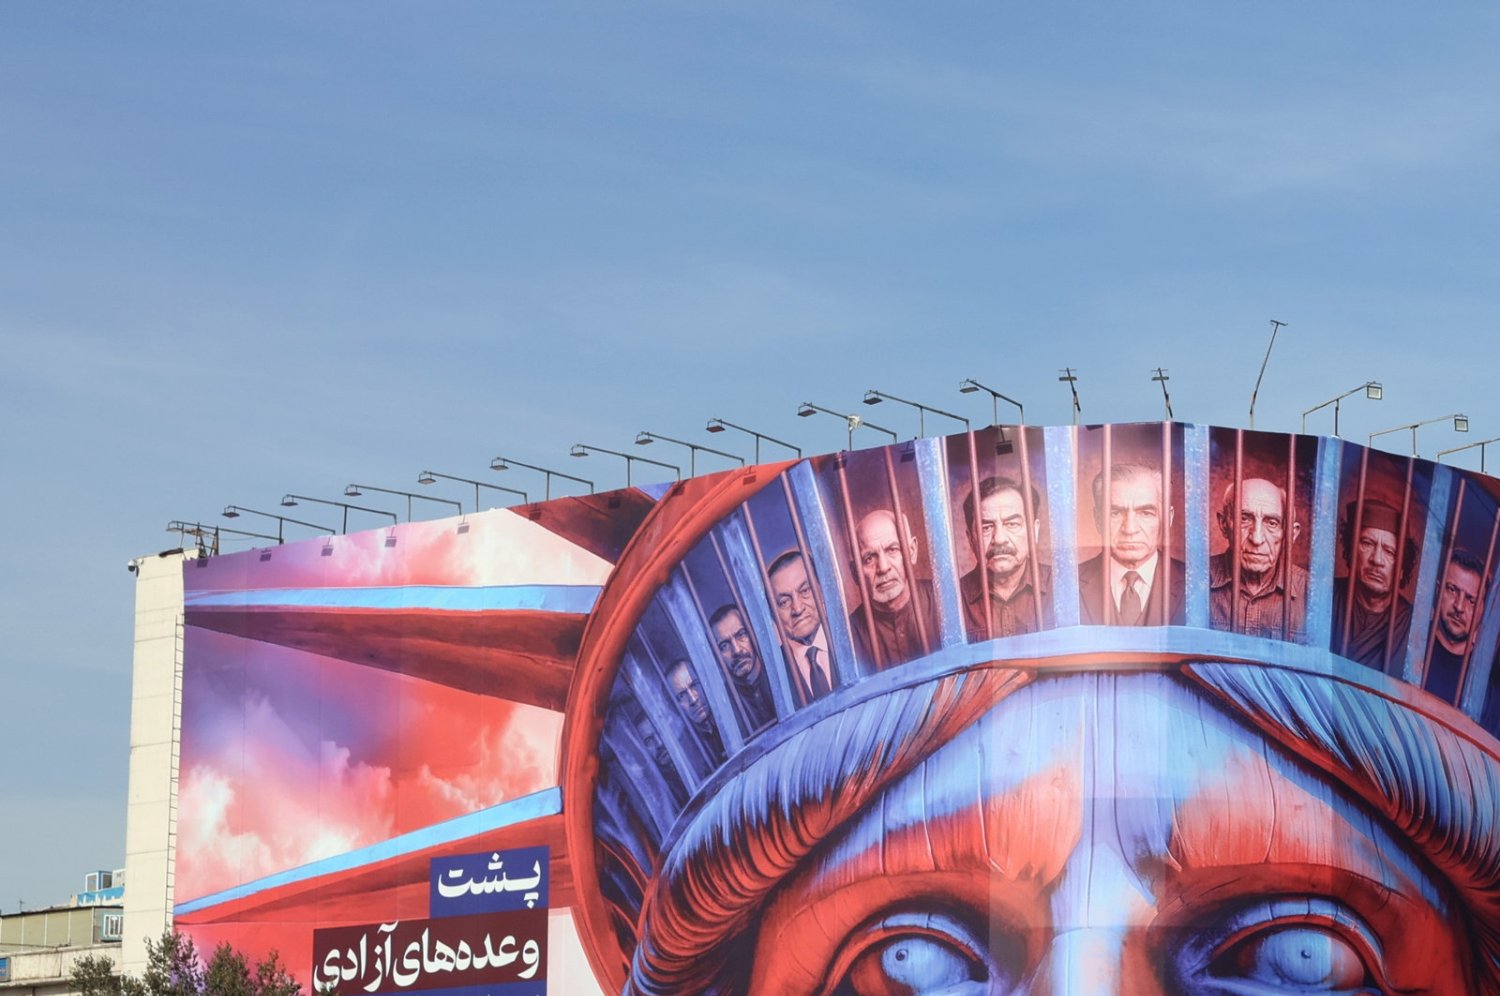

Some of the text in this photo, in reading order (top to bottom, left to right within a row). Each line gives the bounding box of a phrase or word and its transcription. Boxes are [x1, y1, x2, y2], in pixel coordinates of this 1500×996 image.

[438, 852, 541, 909] پشت
[313, 920, 540, 993] وعده‌های آزادی
